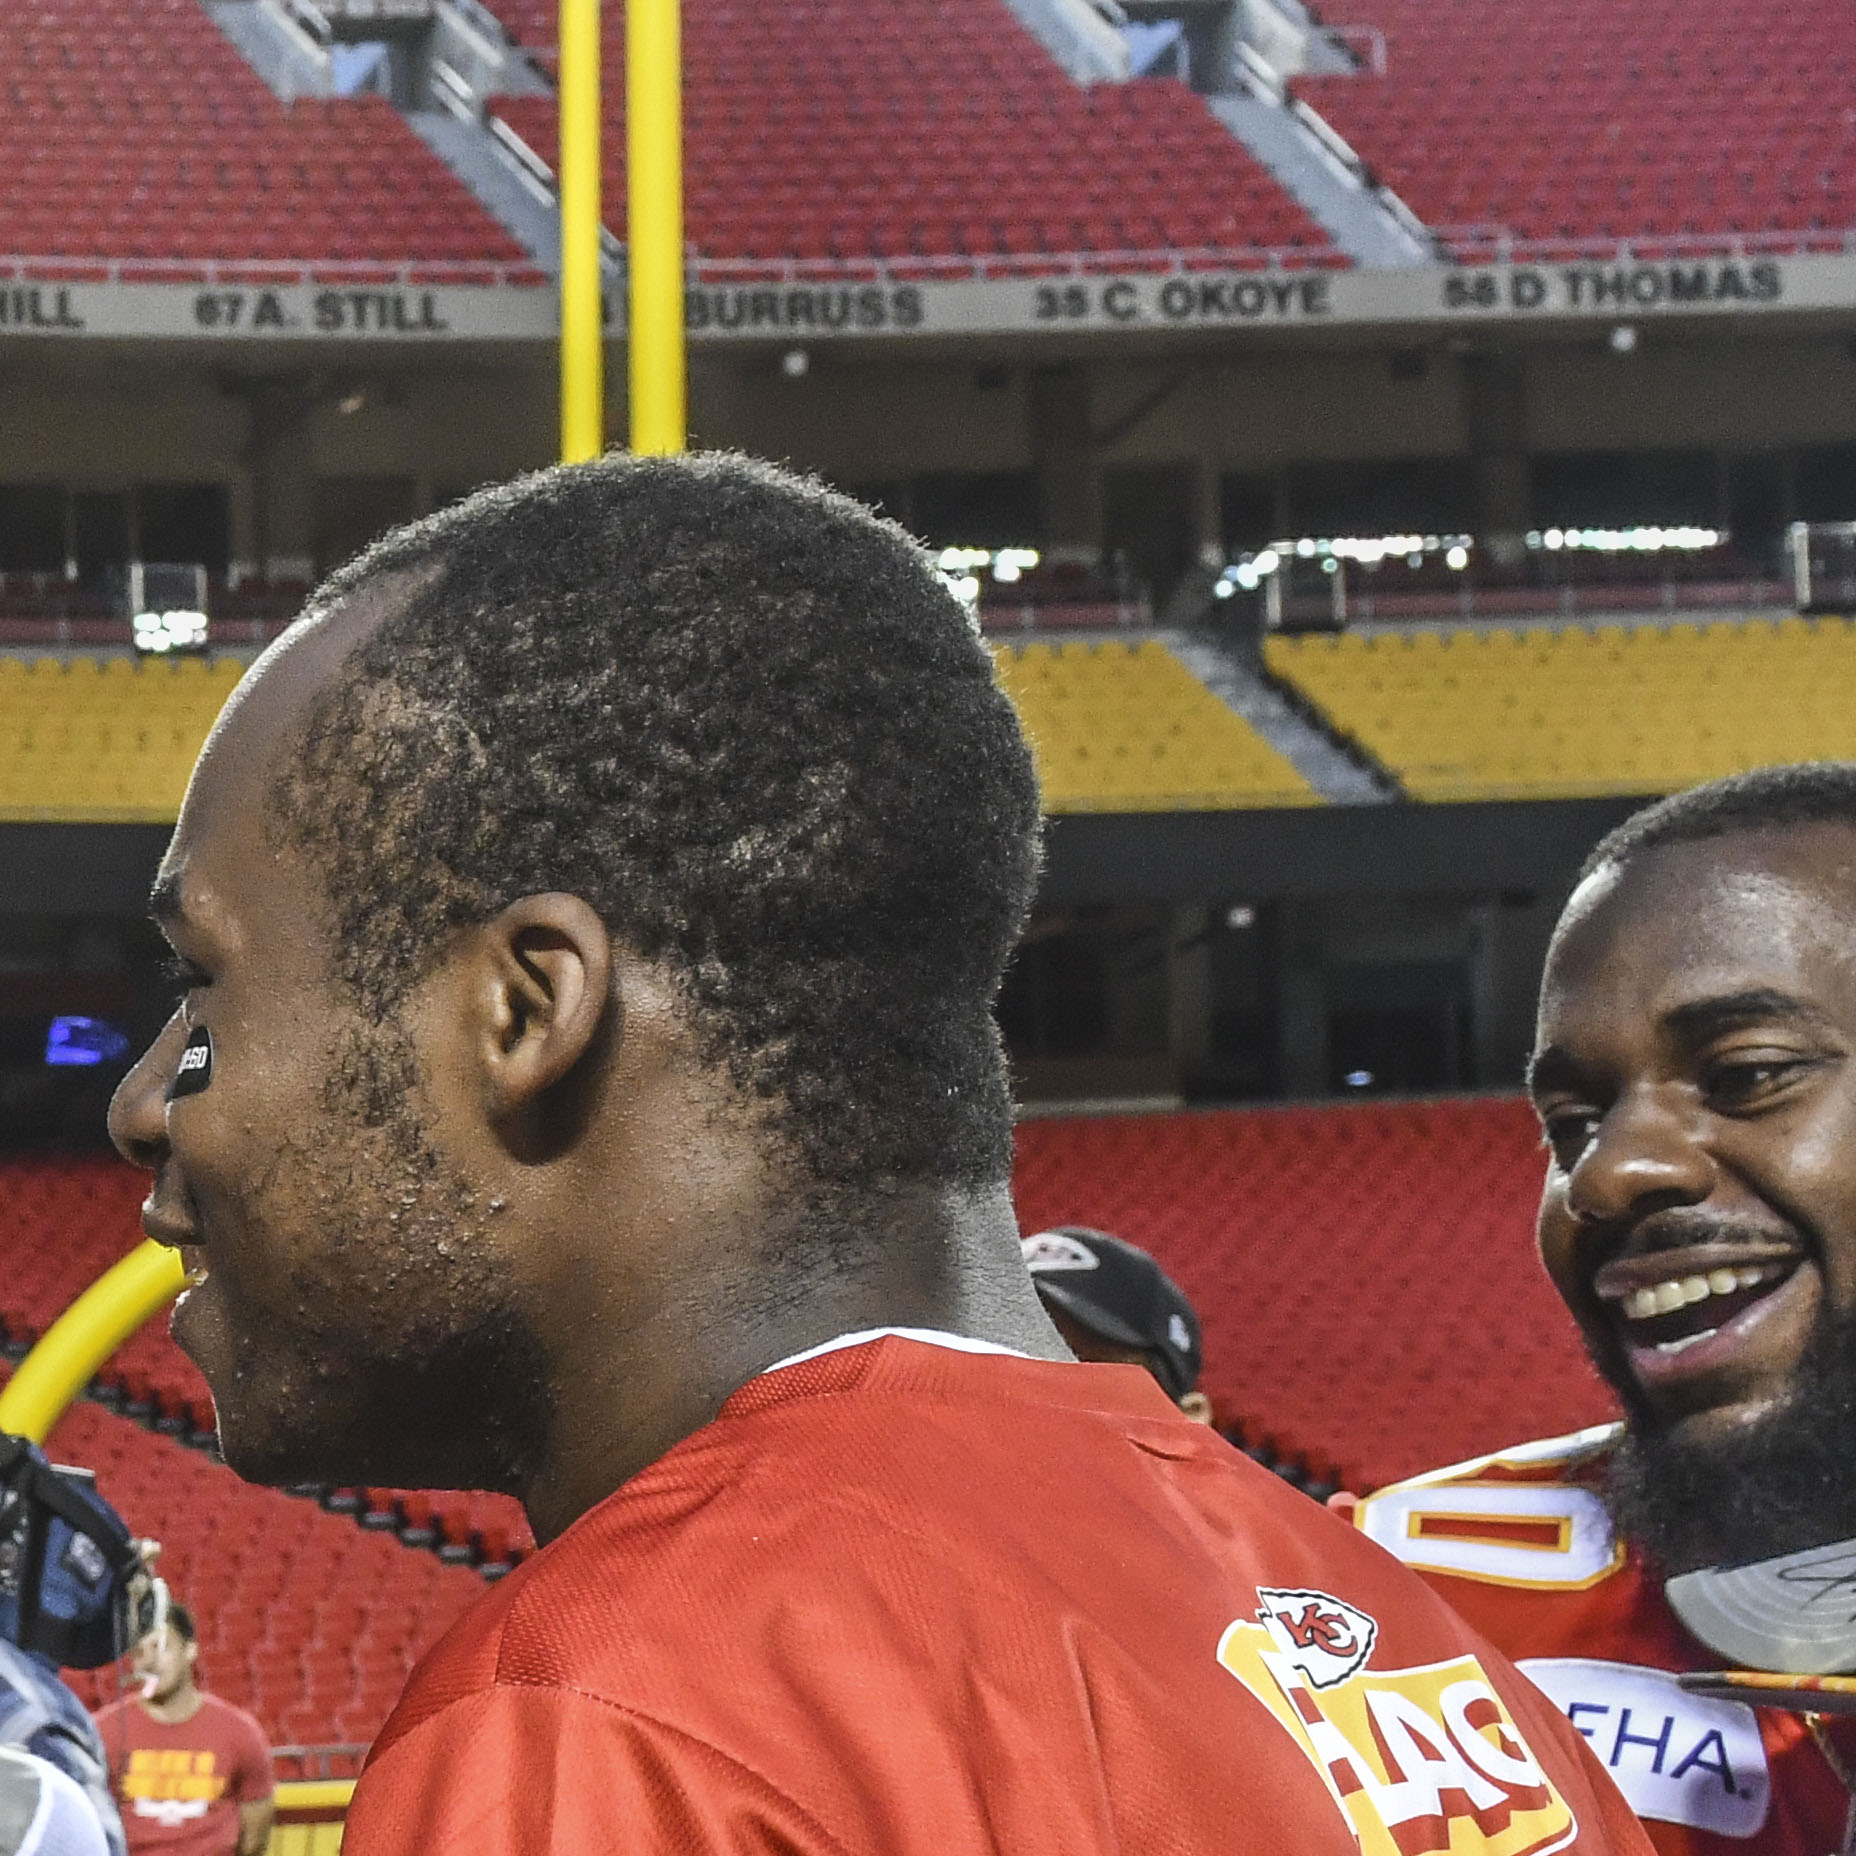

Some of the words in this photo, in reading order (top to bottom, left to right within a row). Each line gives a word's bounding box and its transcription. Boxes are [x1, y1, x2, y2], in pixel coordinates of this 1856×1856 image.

[1159, 276, 1329, 320] OKOYE
[1563, 262, 1783, 306] THOMAS
[312, 292, 448, 331] STILL
